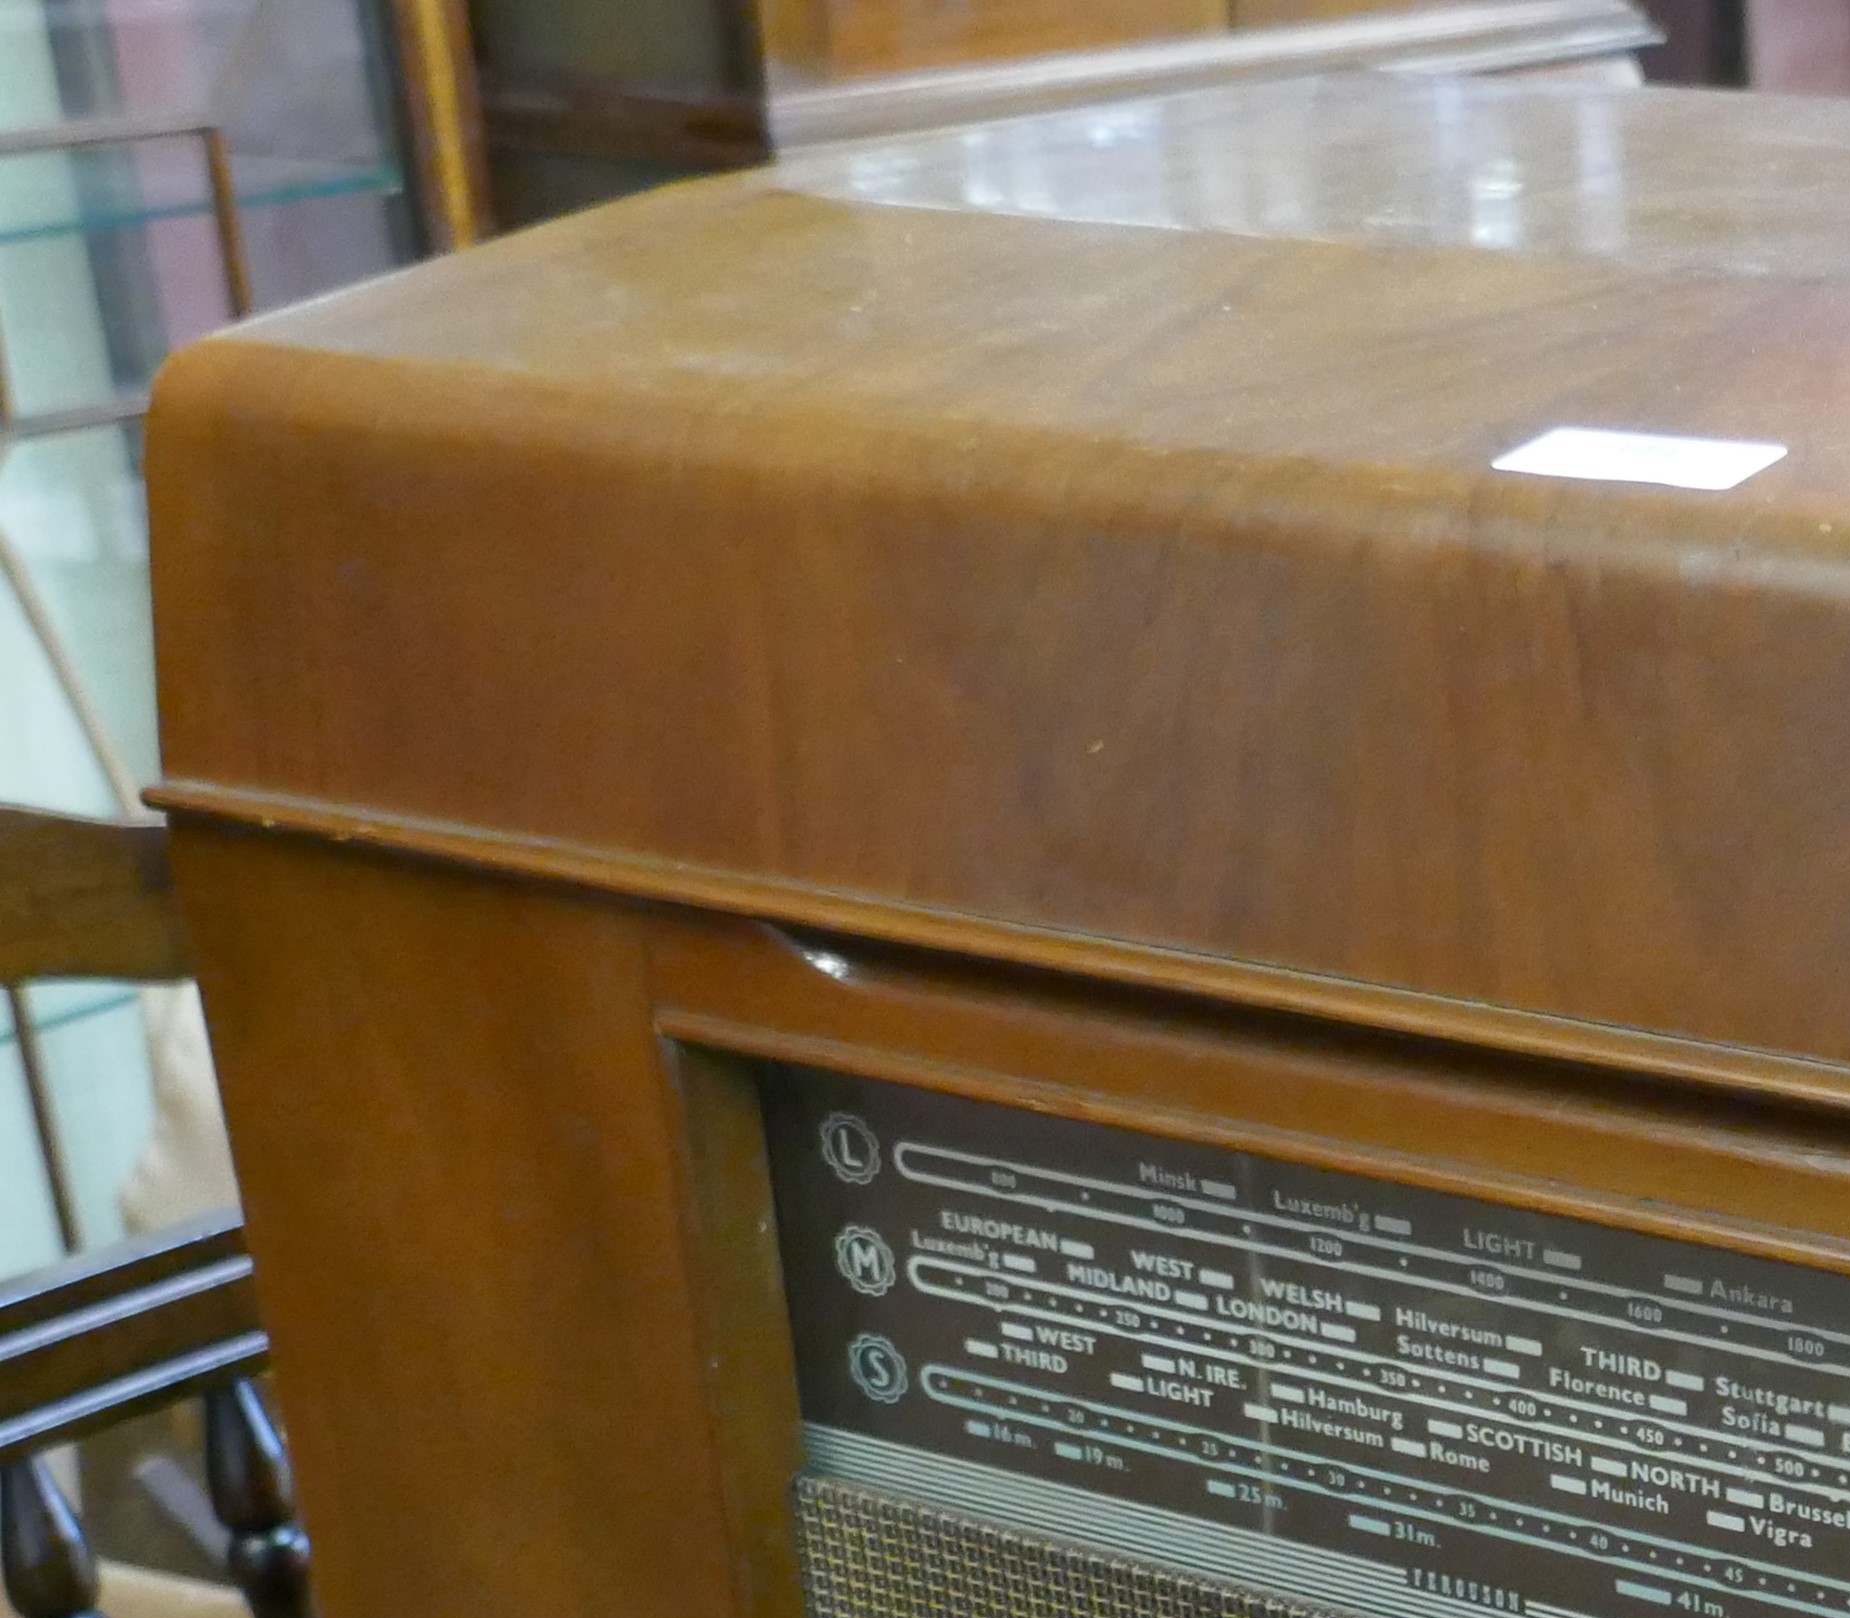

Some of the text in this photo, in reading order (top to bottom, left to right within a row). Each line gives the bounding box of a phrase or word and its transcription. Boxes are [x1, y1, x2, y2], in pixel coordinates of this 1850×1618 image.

[840, 1129, 863, 1167] L
[1139, 1161, 1197, 1192] Minsk
[1273, 1190, 1371, 1232] Luxemb'g
[941, 1209, 1058, 1252] EUROPEAN
[1463, 1228, 1535, 1260] LIGHT
[853, 1242, 880, 1281] M
[1130, 1249, 1195, 1280] WEST
[1067, 1262, 1171, 1301] MIDLAND
[1259, 1278, 1343, 1313] WELSH
[1310, 1236, 1342, 1257] 1200
[1470, 1270, 1504, 1290] 1400
[1627, 1302, 1663, 1323] 1600
[1788, 1336, 1825, 1357] 1800
[1710, 1279, 1793, 1313] Ankara
[1216, 1295, 1319, 1334] LONDON
[1396, 1307, 1503, 1347] Hilversum
[1034, 1325, 1097, 1355] WEST
[1396, 1335, 1481, 1369] Sottens
[869, 1351, 889, 1387] S
[1001, 1343, 1068, 1374] THIRD
[1580, 1346, 1661, 1381] THIRD
[1116, 1310, 1141, 1328] 250
[1380, 1369, 1406, 1388] 350
[1508, 1398, 1537, 1418] 400
[1636, 1427, 1664, 1446] 450
[1775, 1458, 1805, 1477] 500
[1147, 1378, 1214, 1408] LIGHT
[1205, 1364, 1247, 1390] IRE.
[1549, 1366, 1645, 1406] Florence
[1308, 1388, 1403, 1431] Hamburg
[1715, 1376, 1825, 1418] Stuttgart
[1281, 1407, 1384, 1448] Hilversum
[1721, 1406, 1781, 1437] Sofia
[1430, 1441, 1491, 1473] Rome
[1466, 1423, 1582, 1467] SCOTTISH
[1591, 1479, 1670, 1514] Munich
[1631, 1461, 1720, 1498] NORTH
[1202, 1441, 1218, 1457] 25
[1328, 1470, 1346, 1487] 30
[1459, 1501, 1476, 1518] 35
[1590, 1532, 1609, 1550] 40
[1725, 1566, 1744, 1583] 45
[1749, 1515, 1813, 1548] Vigra
